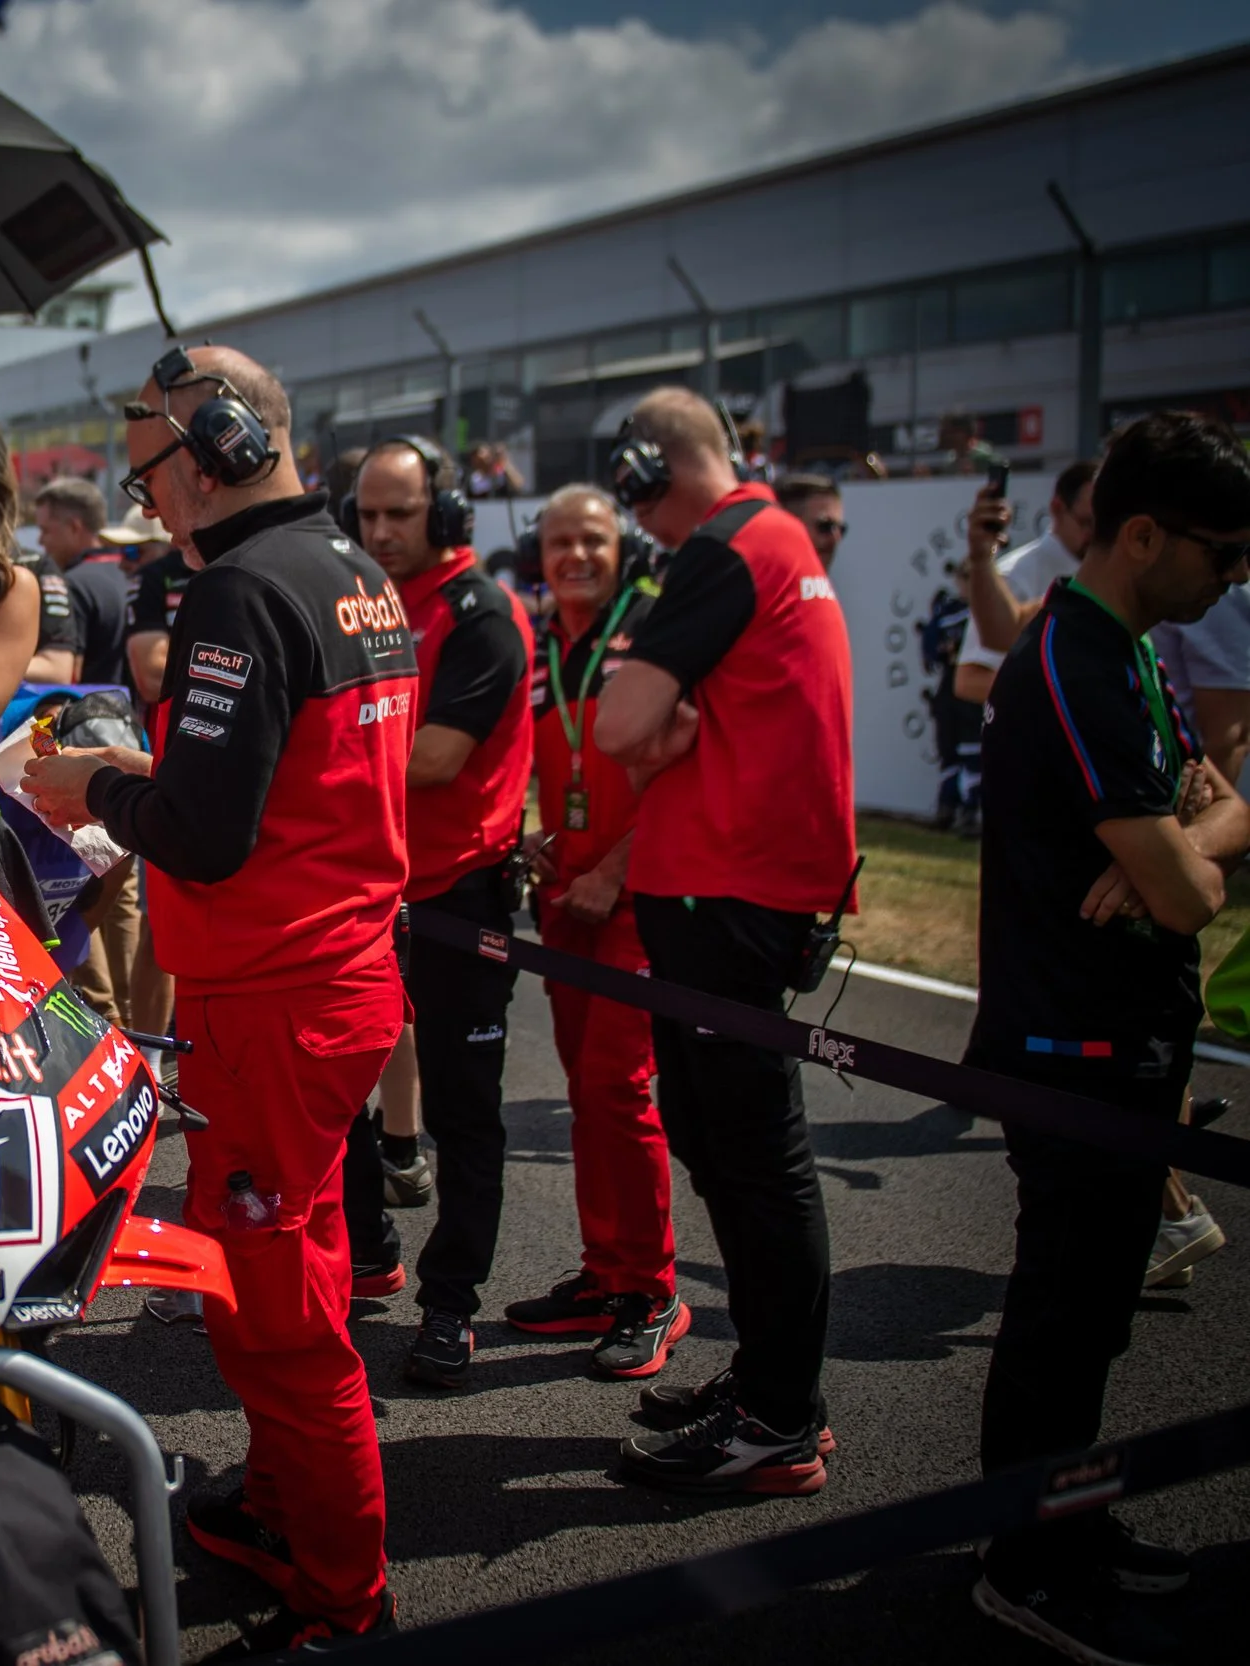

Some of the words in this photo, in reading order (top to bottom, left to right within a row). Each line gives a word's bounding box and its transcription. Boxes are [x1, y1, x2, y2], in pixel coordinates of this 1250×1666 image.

[336, 575, 410, 637] aruba.it
[198, 648, 243, 671] aruba.it
[187, 688, 234, 713] PIRELLI
[83, 1084, 155, 1180] Lenovo
